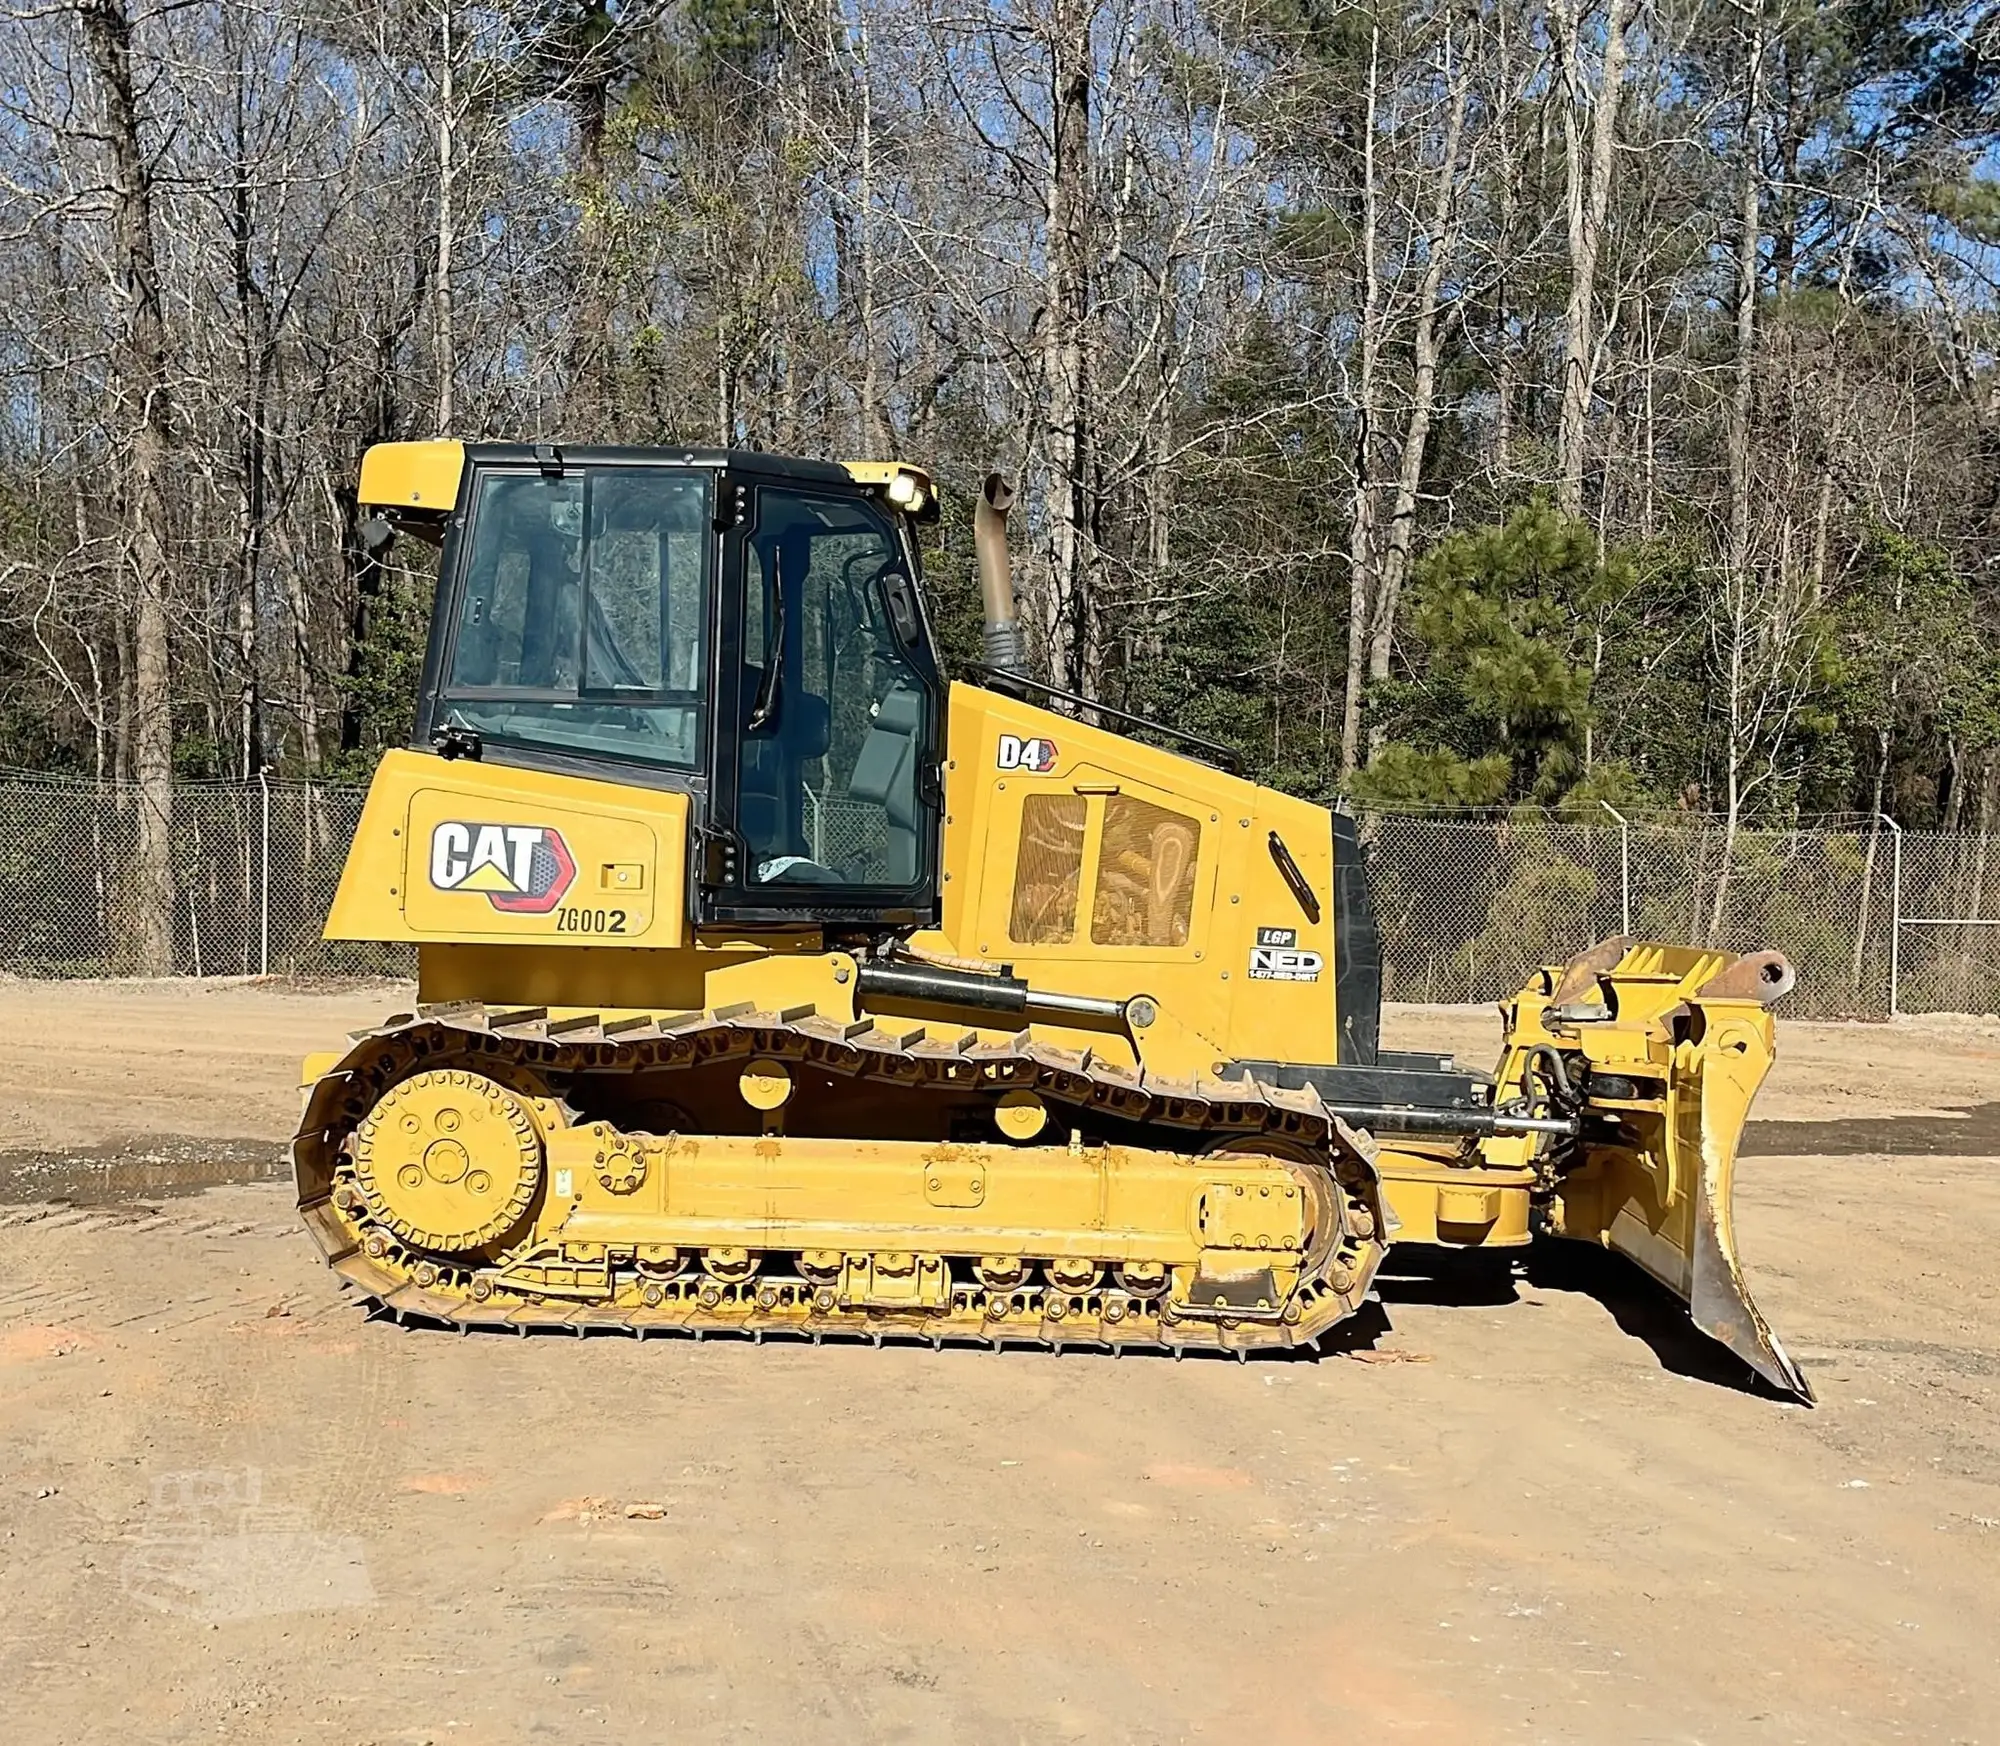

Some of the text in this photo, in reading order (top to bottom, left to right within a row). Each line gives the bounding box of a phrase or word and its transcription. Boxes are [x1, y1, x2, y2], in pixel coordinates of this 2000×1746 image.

[999, 734, 1041, 770] D4
[431, 822, 543, 893] CAT
[557, 908, 627, 933] ZG002
[1262, 930, 1292, 945] LGP
[1249, 949, 1324, 973] NED
